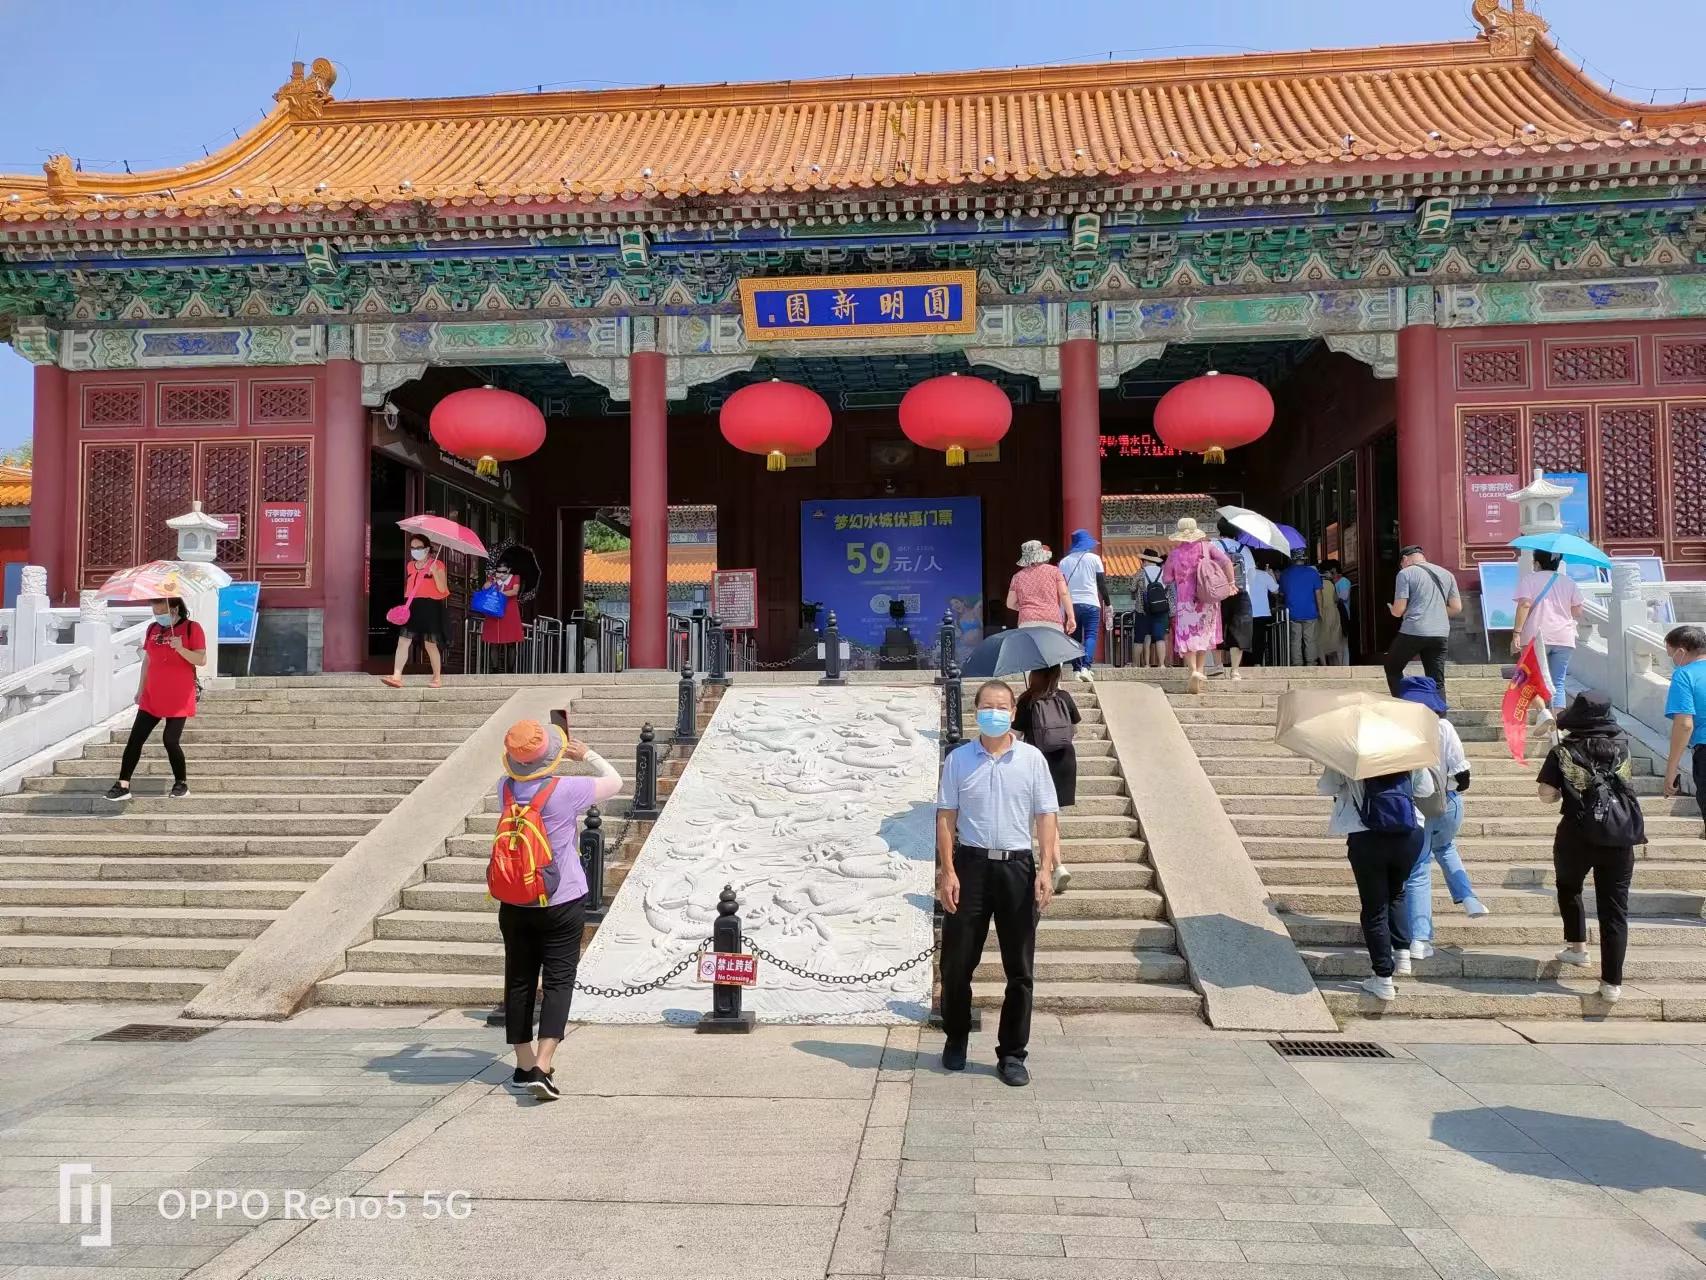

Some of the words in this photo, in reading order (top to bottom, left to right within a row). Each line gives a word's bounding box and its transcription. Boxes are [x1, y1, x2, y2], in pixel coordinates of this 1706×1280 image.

[786, 286, 950, 324] 圓明新園
[834, 510, 953, 530] 梦幻水城优惠门票
[717, 958, 753, 973] 禁止跨越
[726, 974, 750, 983] Crossing
